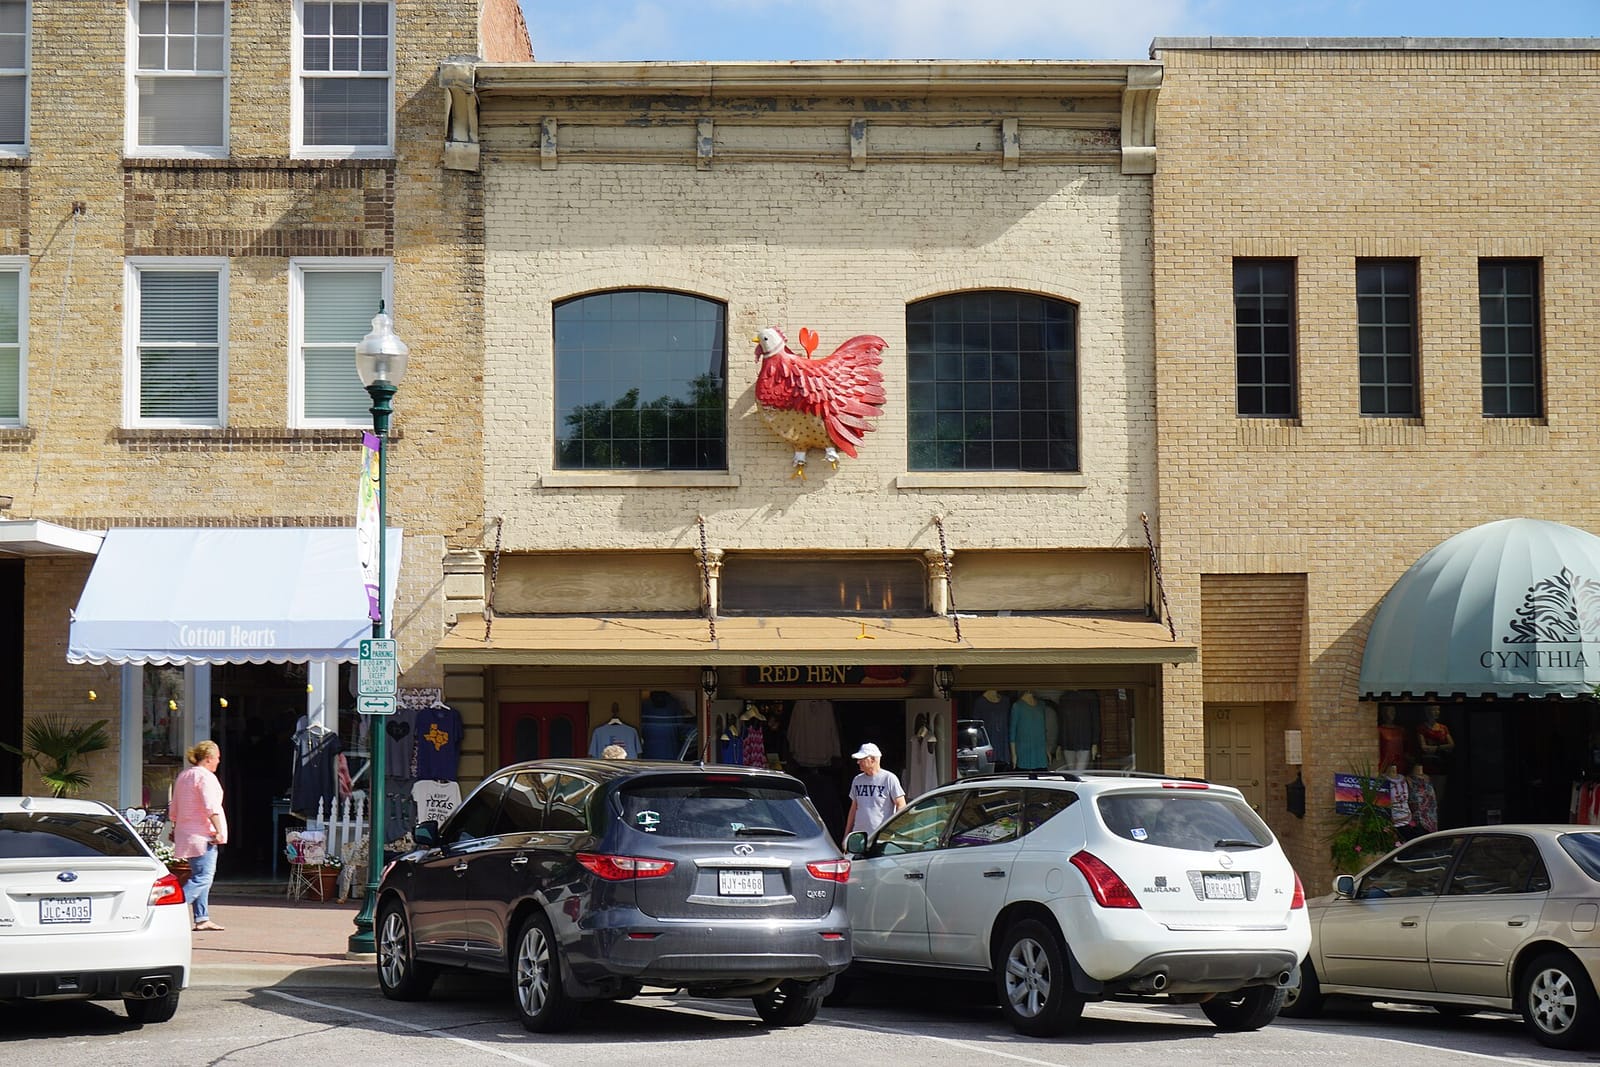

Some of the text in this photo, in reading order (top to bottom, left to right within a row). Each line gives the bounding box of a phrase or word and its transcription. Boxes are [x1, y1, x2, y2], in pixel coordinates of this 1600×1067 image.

[179, 624, 276, 647] Cotton Hearts
[361, 643, 370, 658] 3
[372, 650, 393, 658] PARKING
[1480, 650, 1589, 669] CYNTHIA
[757, 664, 800, 683] RED
[856, 784, 886, 797] NAVY
[425, 798, 454, 810] TEXAS
[806, 890, 826, 898] QX60
